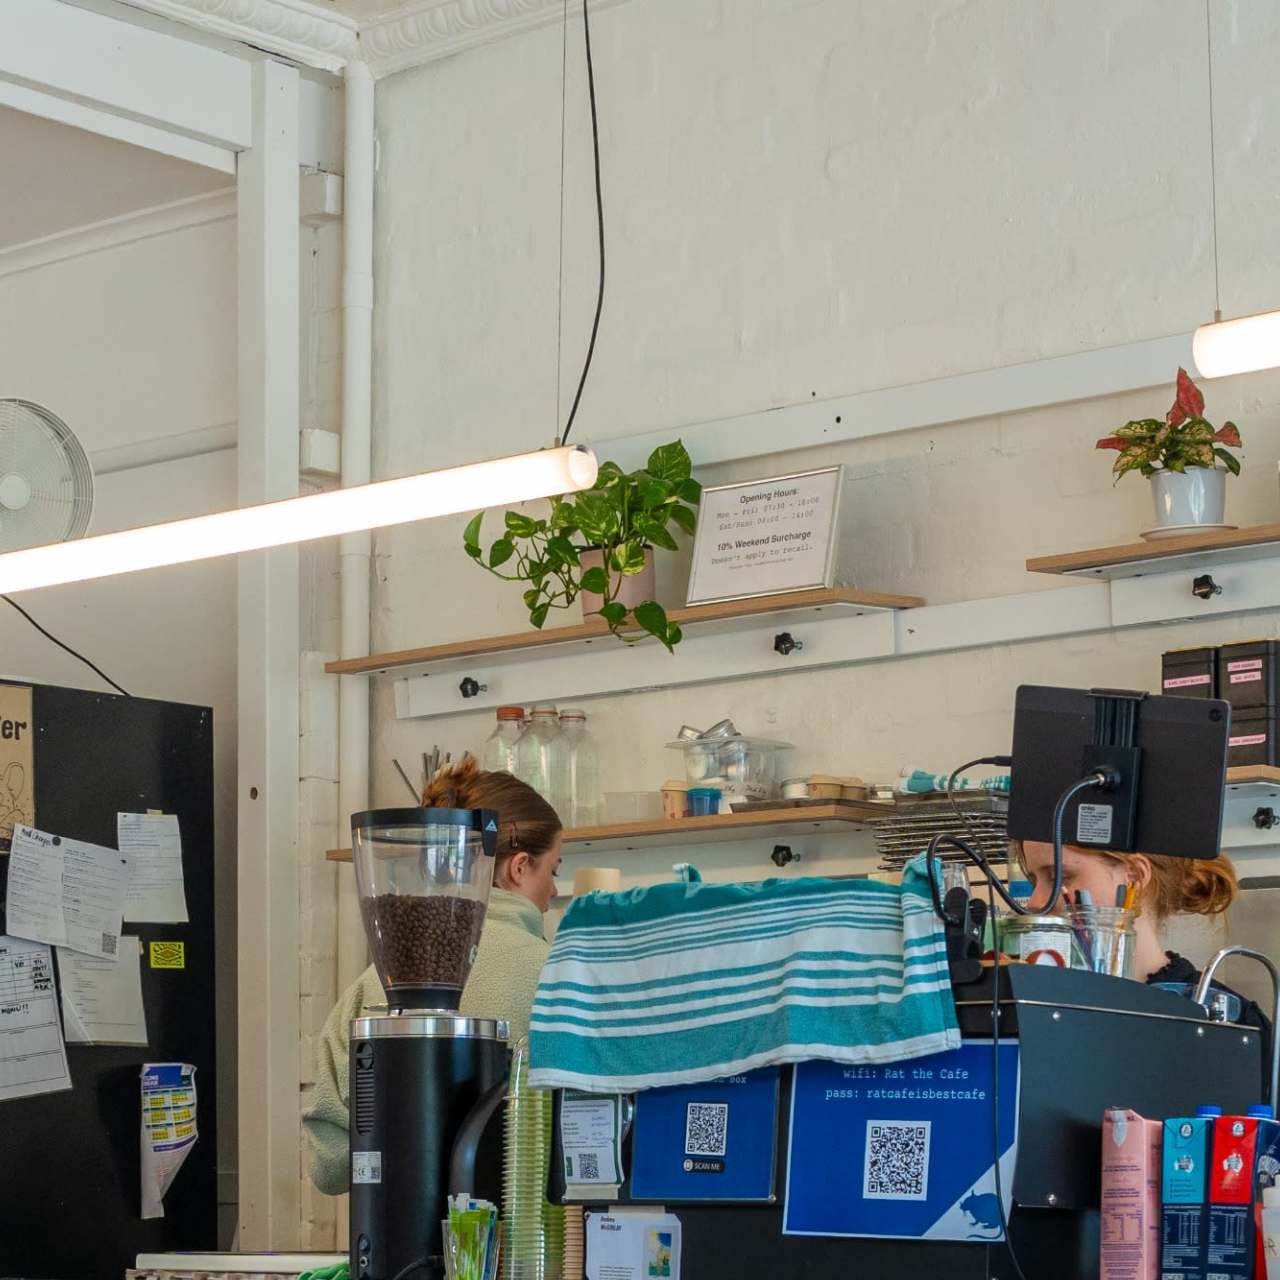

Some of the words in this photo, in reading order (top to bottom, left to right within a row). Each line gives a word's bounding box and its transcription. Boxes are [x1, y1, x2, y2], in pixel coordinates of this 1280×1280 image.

[740, 491, 772, 505] Opening
[773, 487, 800, 498] Hours:
[717, 541, 733, 551] 10%
[735, 534, 770, 549] Weekend
[771, 530, 812, 544] Surcharge
[843, 1068, 876, 1079] wifi:
[884, 1068, 905, 1079] Rat
[912, 1068, 933, 1079] the
[940, 1067, 969, 1079] Cafe
[825, 1088, 859, 1100] pass:
[866, 1087, 986, 1100] ratcafeisbestcafe
[694, 1162, 708, 1170] SCAN
[709, 1162, 720, 1171] ME
